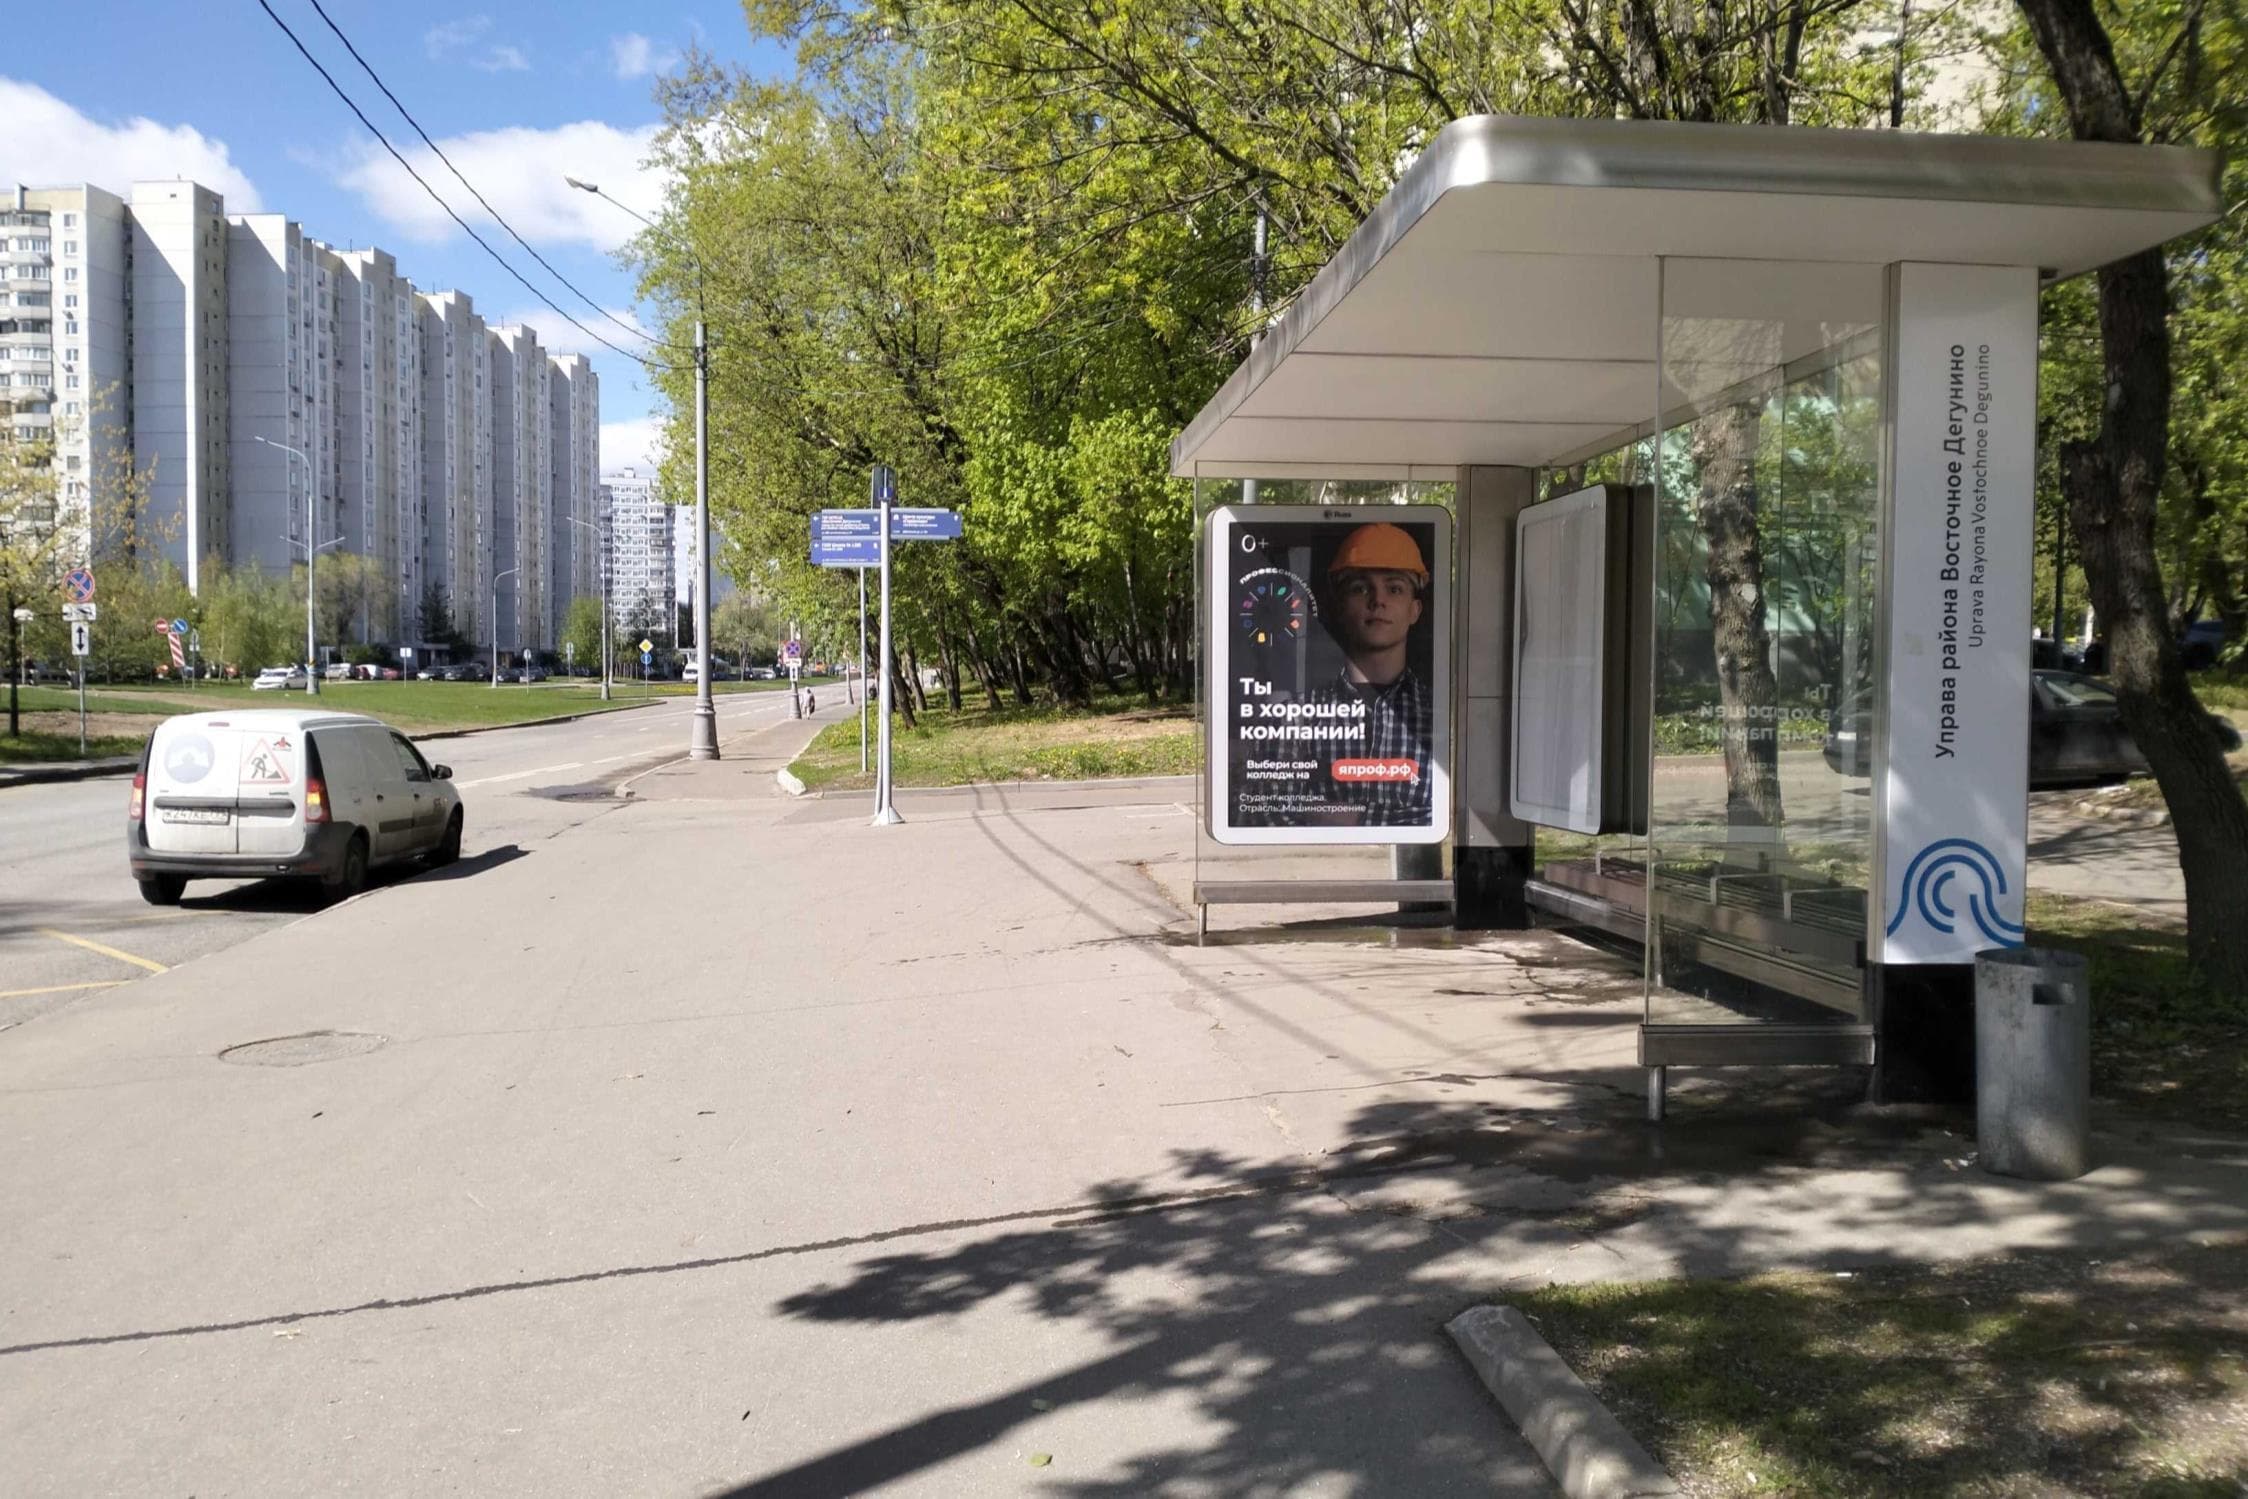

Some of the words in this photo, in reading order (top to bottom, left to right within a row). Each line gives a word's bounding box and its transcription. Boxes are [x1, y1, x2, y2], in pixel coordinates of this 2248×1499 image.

[1943, 344, 1968, 455] Дегунино
[1973, 344, 1992, 424] Degunino
[1971, 428, 1988, 524] Vostochnoe
[1941, 461, 1962, 581] Восточное
[1241, 534, 1269, 553] 0+
[1969, 526, 1988, 585] Rayona
[1938, 588, 1960, 669] района
[1968, 589, 1986, 648] Uprava
[1239, 677, 1272, 695] Ты
[1240, 703, 1254, 718] в
[1259, 698, 1366, 722] хорошей
[1935, 677, 1959, 758] Управа
[1240, 722, 1366, 740] компании!
[1246, 759, 1290, 771] Выбери
[1291, 759, 1318, 770] свой
[1246, 771, 1295, 781] колледж
[1296, 771, 1310, 780] на
[1338, 762, 1412, 778] япроф.рф
[1282, 804, 1367, 813] Машиностроение
